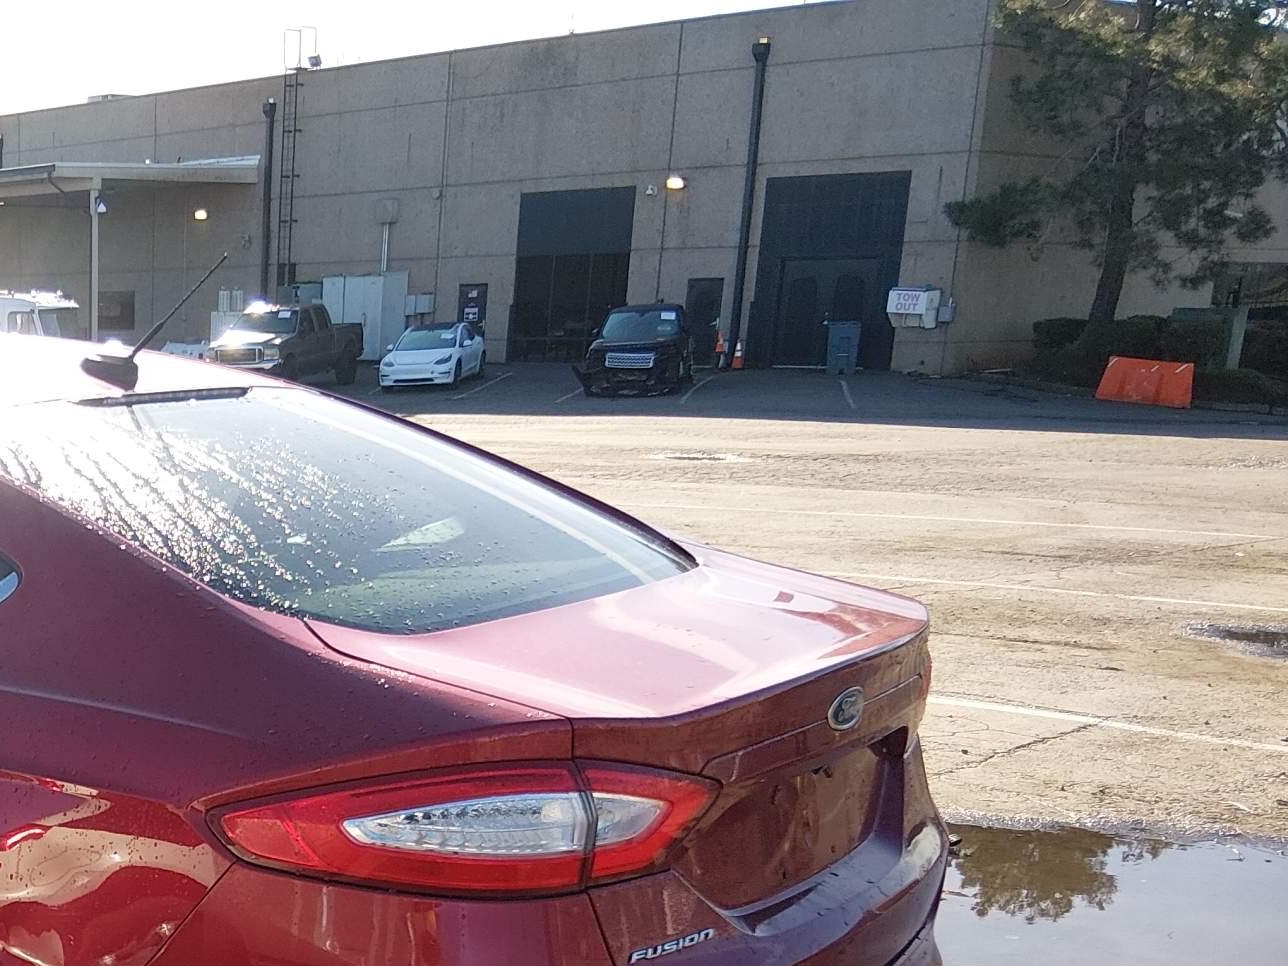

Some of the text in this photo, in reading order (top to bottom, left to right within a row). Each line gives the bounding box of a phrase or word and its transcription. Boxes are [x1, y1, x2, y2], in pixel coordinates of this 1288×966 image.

[897, 293, 921, 302] TOW
[896, 302, 918, 311] OUT
[628, 927, 715, 965] FUSION
